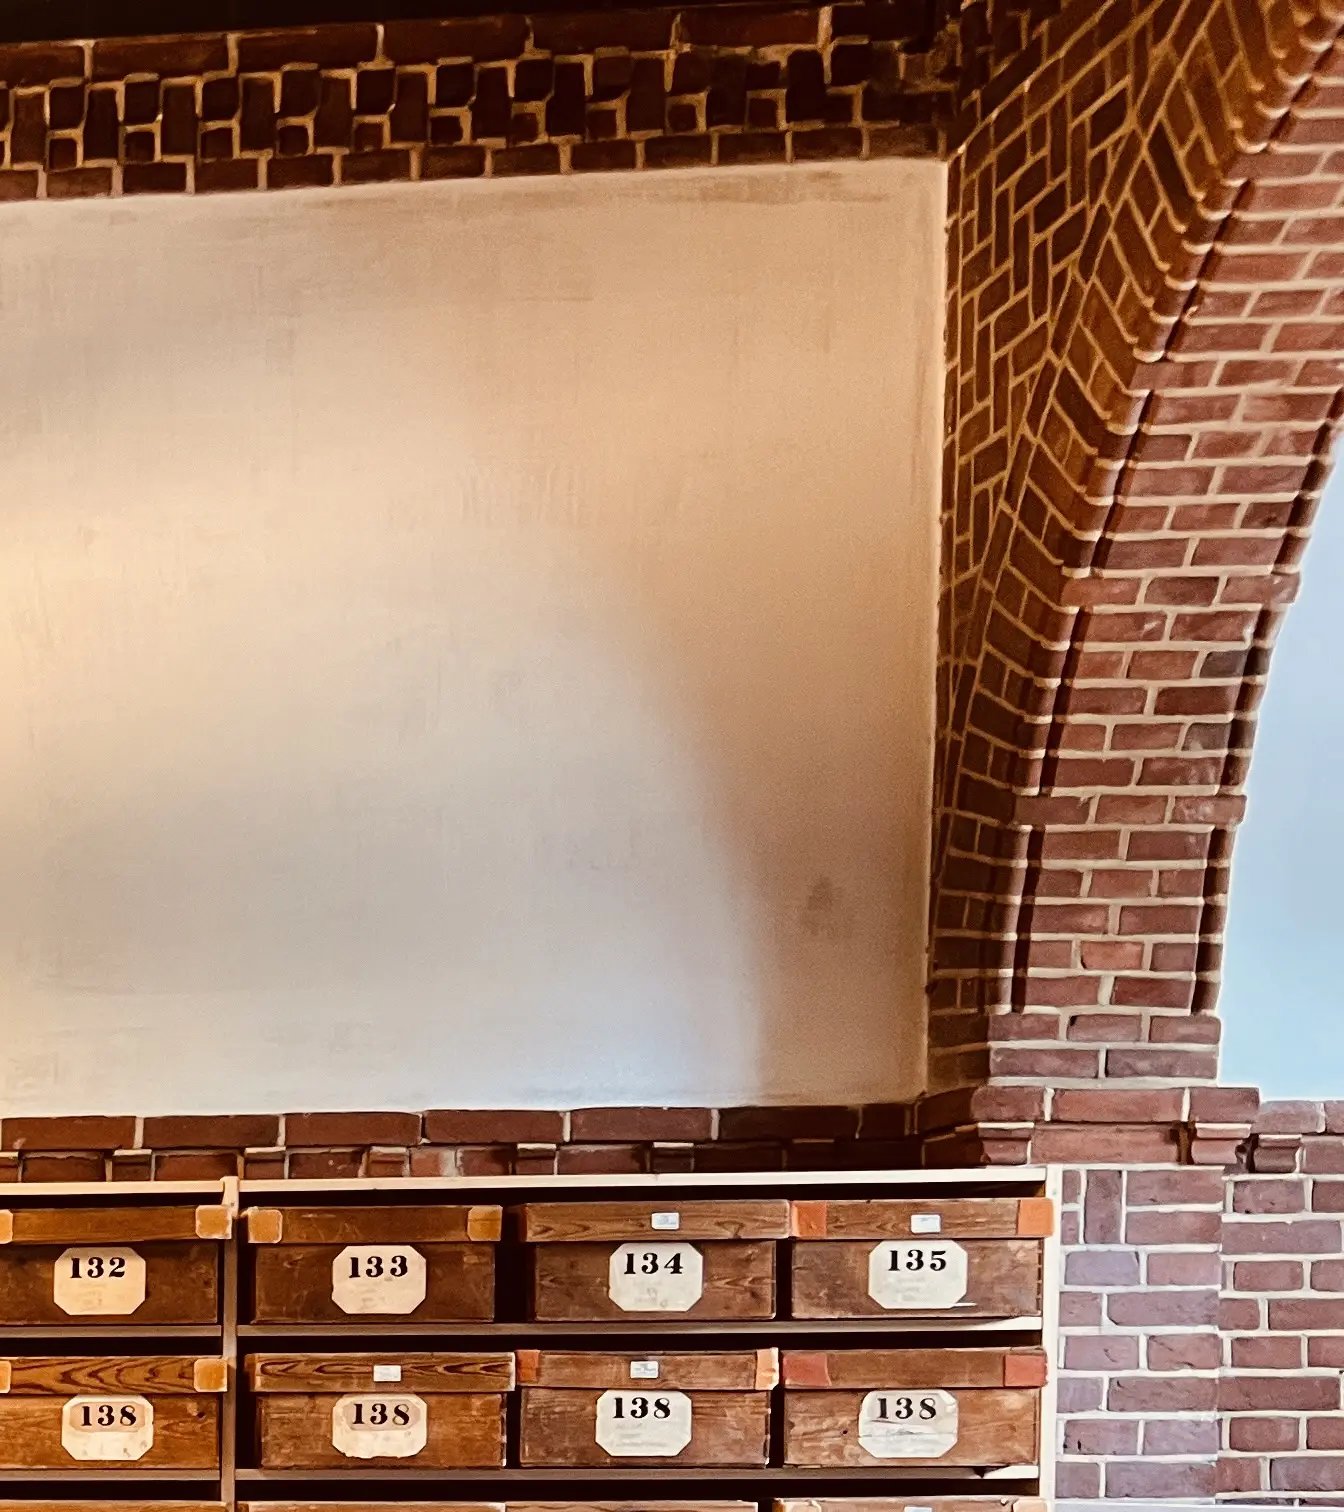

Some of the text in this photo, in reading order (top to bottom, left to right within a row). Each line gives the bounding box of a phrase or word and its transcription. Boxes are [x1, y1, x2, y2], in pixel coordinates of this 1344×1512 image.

[70, 1256, 126, 1279] 132
[348, 1255, 408, 1279] 133
[623, 1252, 684, 1275] 134
[888, 1249, 947, 1272] 135
[81, 1404, 137, 1427] 138
[352, 1403, 410, 1426] 138
[612, 1396, 671, 1419] 138
[877, 1397, 937, 1421] 138
